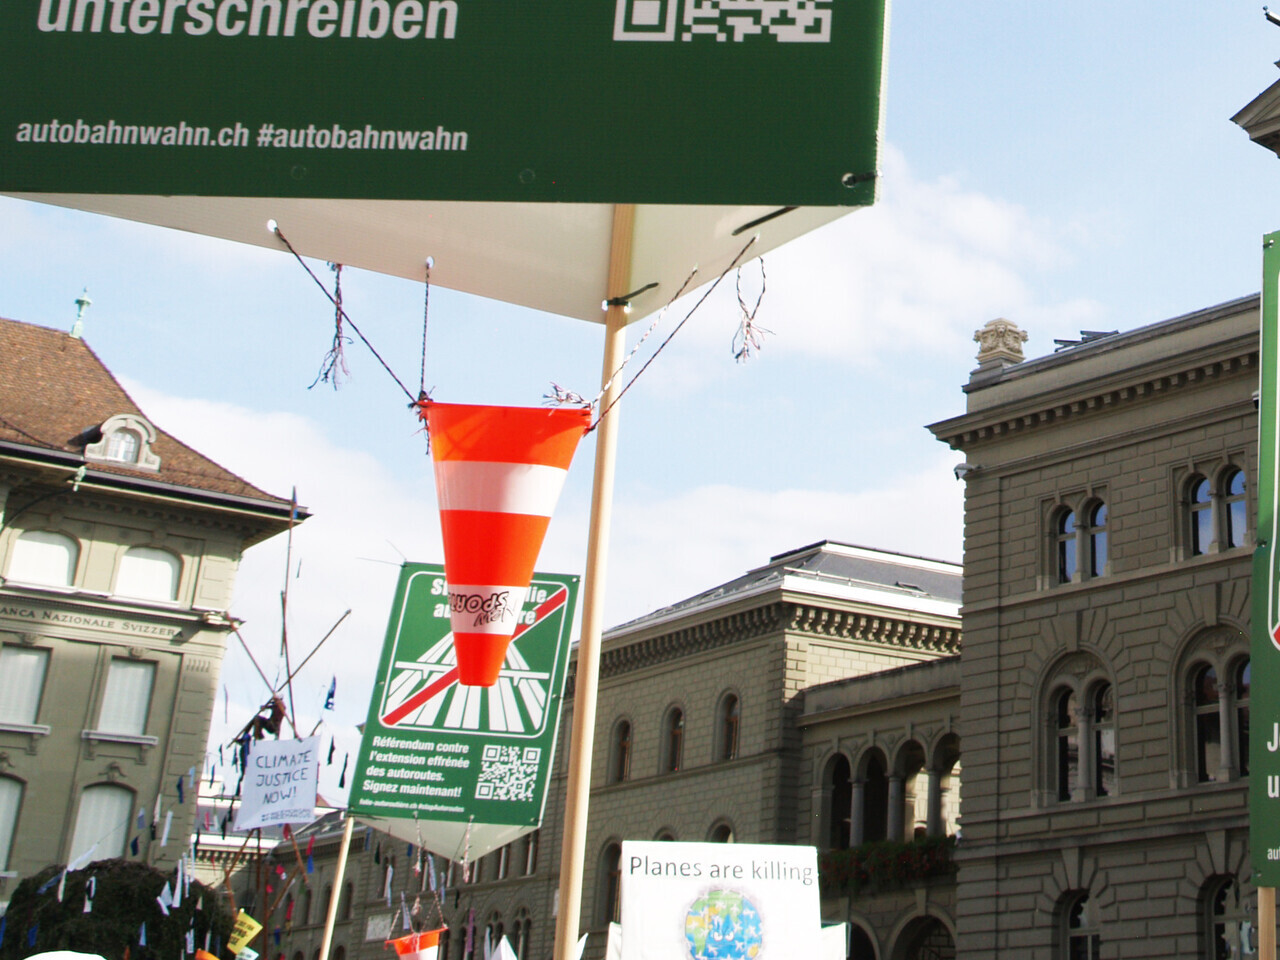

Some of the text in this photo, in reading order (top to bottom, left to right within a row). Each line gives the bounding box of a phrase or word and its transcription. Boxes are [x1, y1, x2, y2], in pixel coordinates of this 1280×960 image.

[15, 118, 468, 152] autobahnwahn.ch #autobahnwahn
[0, 606, 184, 638] ANCA NAZIONALE SVIZZERA
[373, 736, 469, 754] Référendum contre
[256, 750, 312, 768] CLIMATE
[427, 755, 470, 768] effrénée
[256, 768, 309, 787] JUSTICE
[366, 766, 445, 781] des autoroutes.
[263, 786, 297, 804] NOW!
[363, 780, 462, 797] Signez maintenant!
[630, 855, 813, 886] Planes are killing
